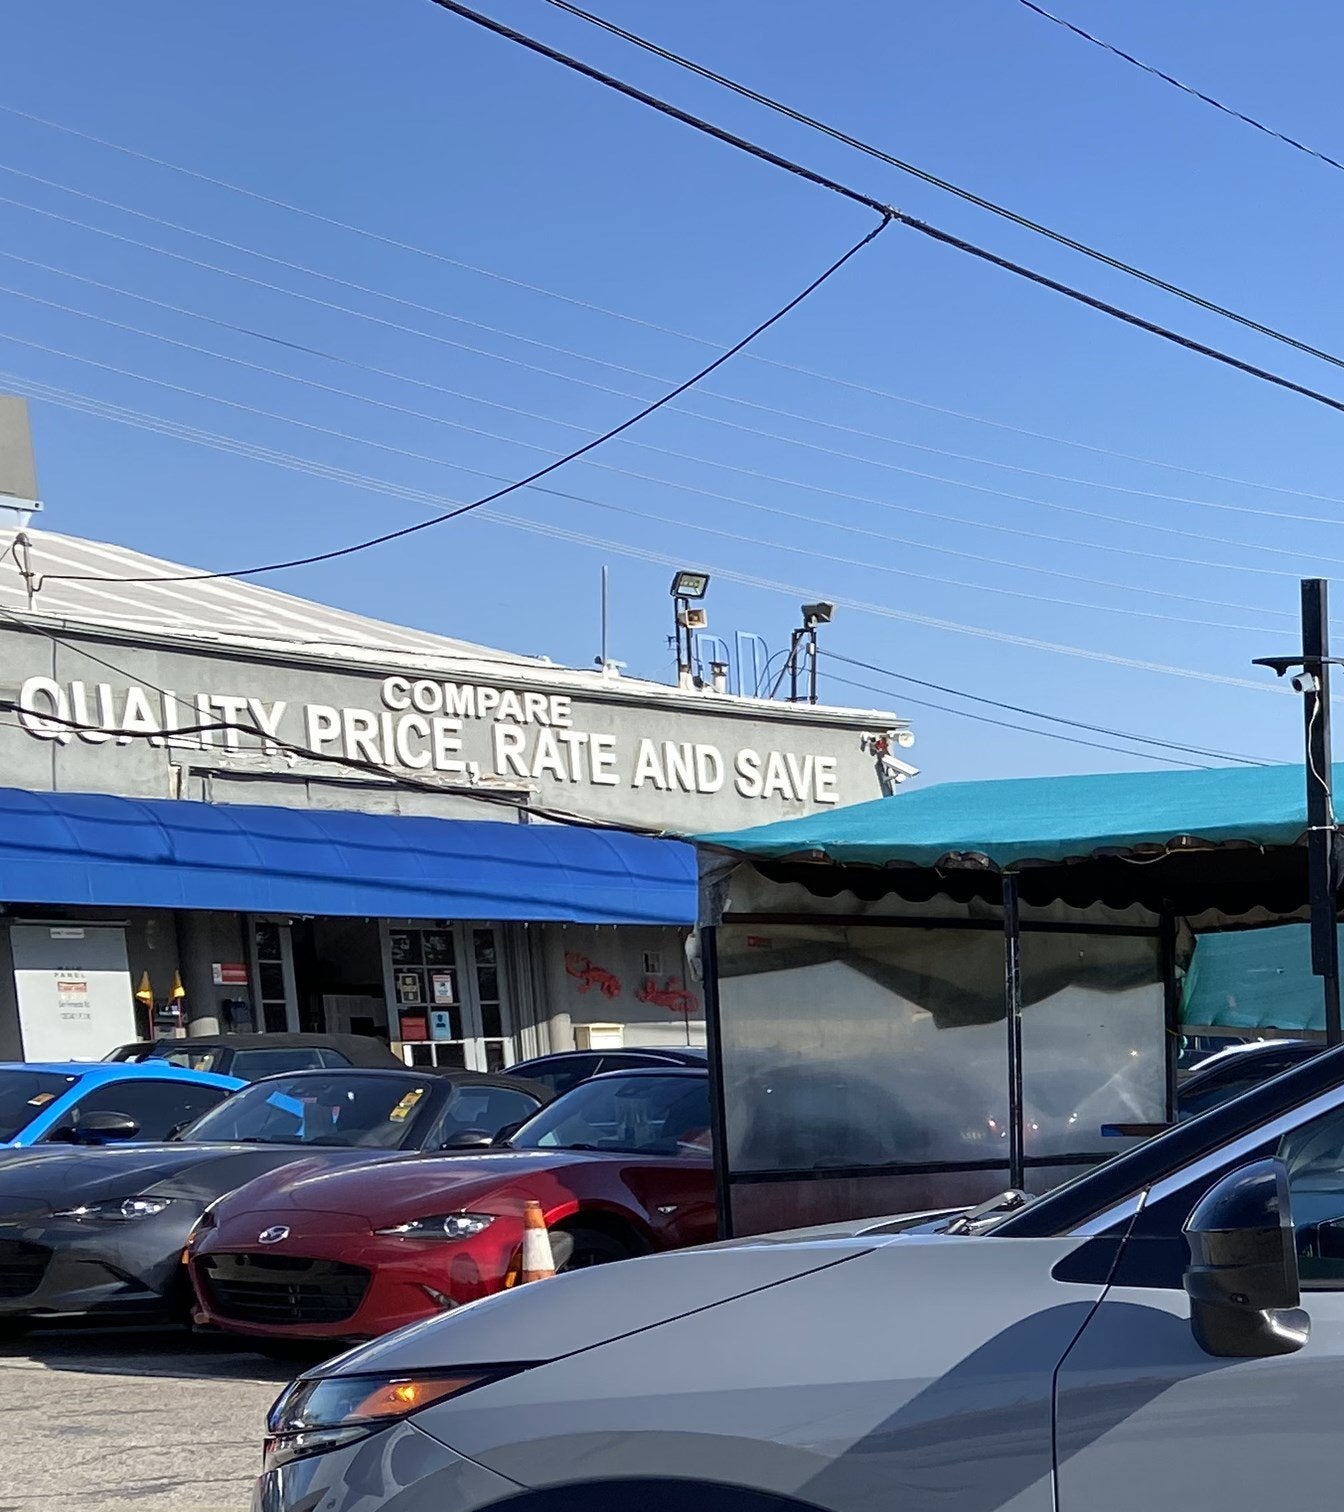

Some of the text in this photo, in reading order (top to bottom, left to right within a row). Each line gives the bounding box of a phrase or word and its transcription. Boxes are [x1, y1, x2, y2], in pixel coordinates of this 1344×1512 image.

[381, 676, 573, 727] COMPARE
[305, 704, 479, 783] PRICE,
[492, 723, 621, 786] RATE
[631, 738, 724, 794] AND
[734, 748, 840, 804] SAVE
